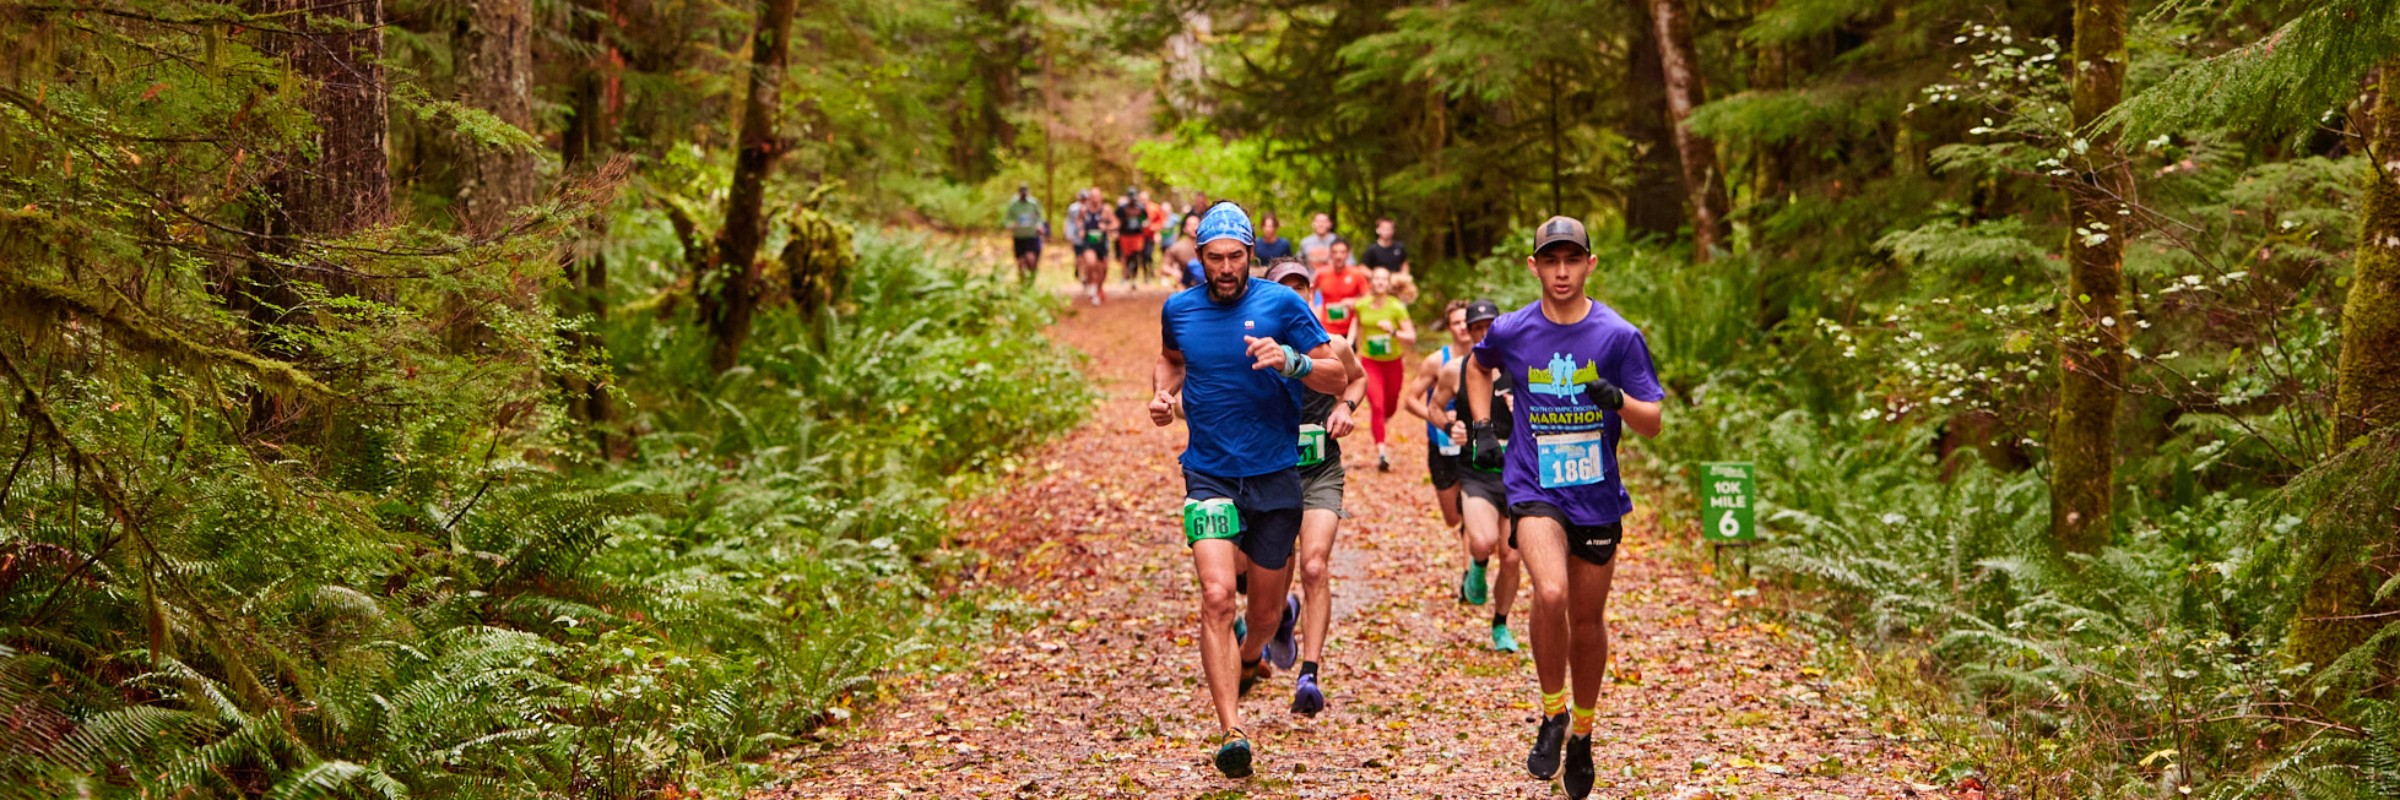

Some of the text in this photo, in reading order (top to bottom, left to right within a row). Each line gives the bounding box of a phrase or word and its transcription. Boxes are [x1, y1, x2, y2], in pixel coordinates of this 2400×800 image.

[1529, 410, 1603, 424] MARATHON
[1553, 458, 1590, 483] 186
[1715, 481, 1741, 494] 10K
[1710, 495, 1746, 508] MILE
[1194, 515, 1229, 535] 608
[1719, 510, 1739, 537] 6
